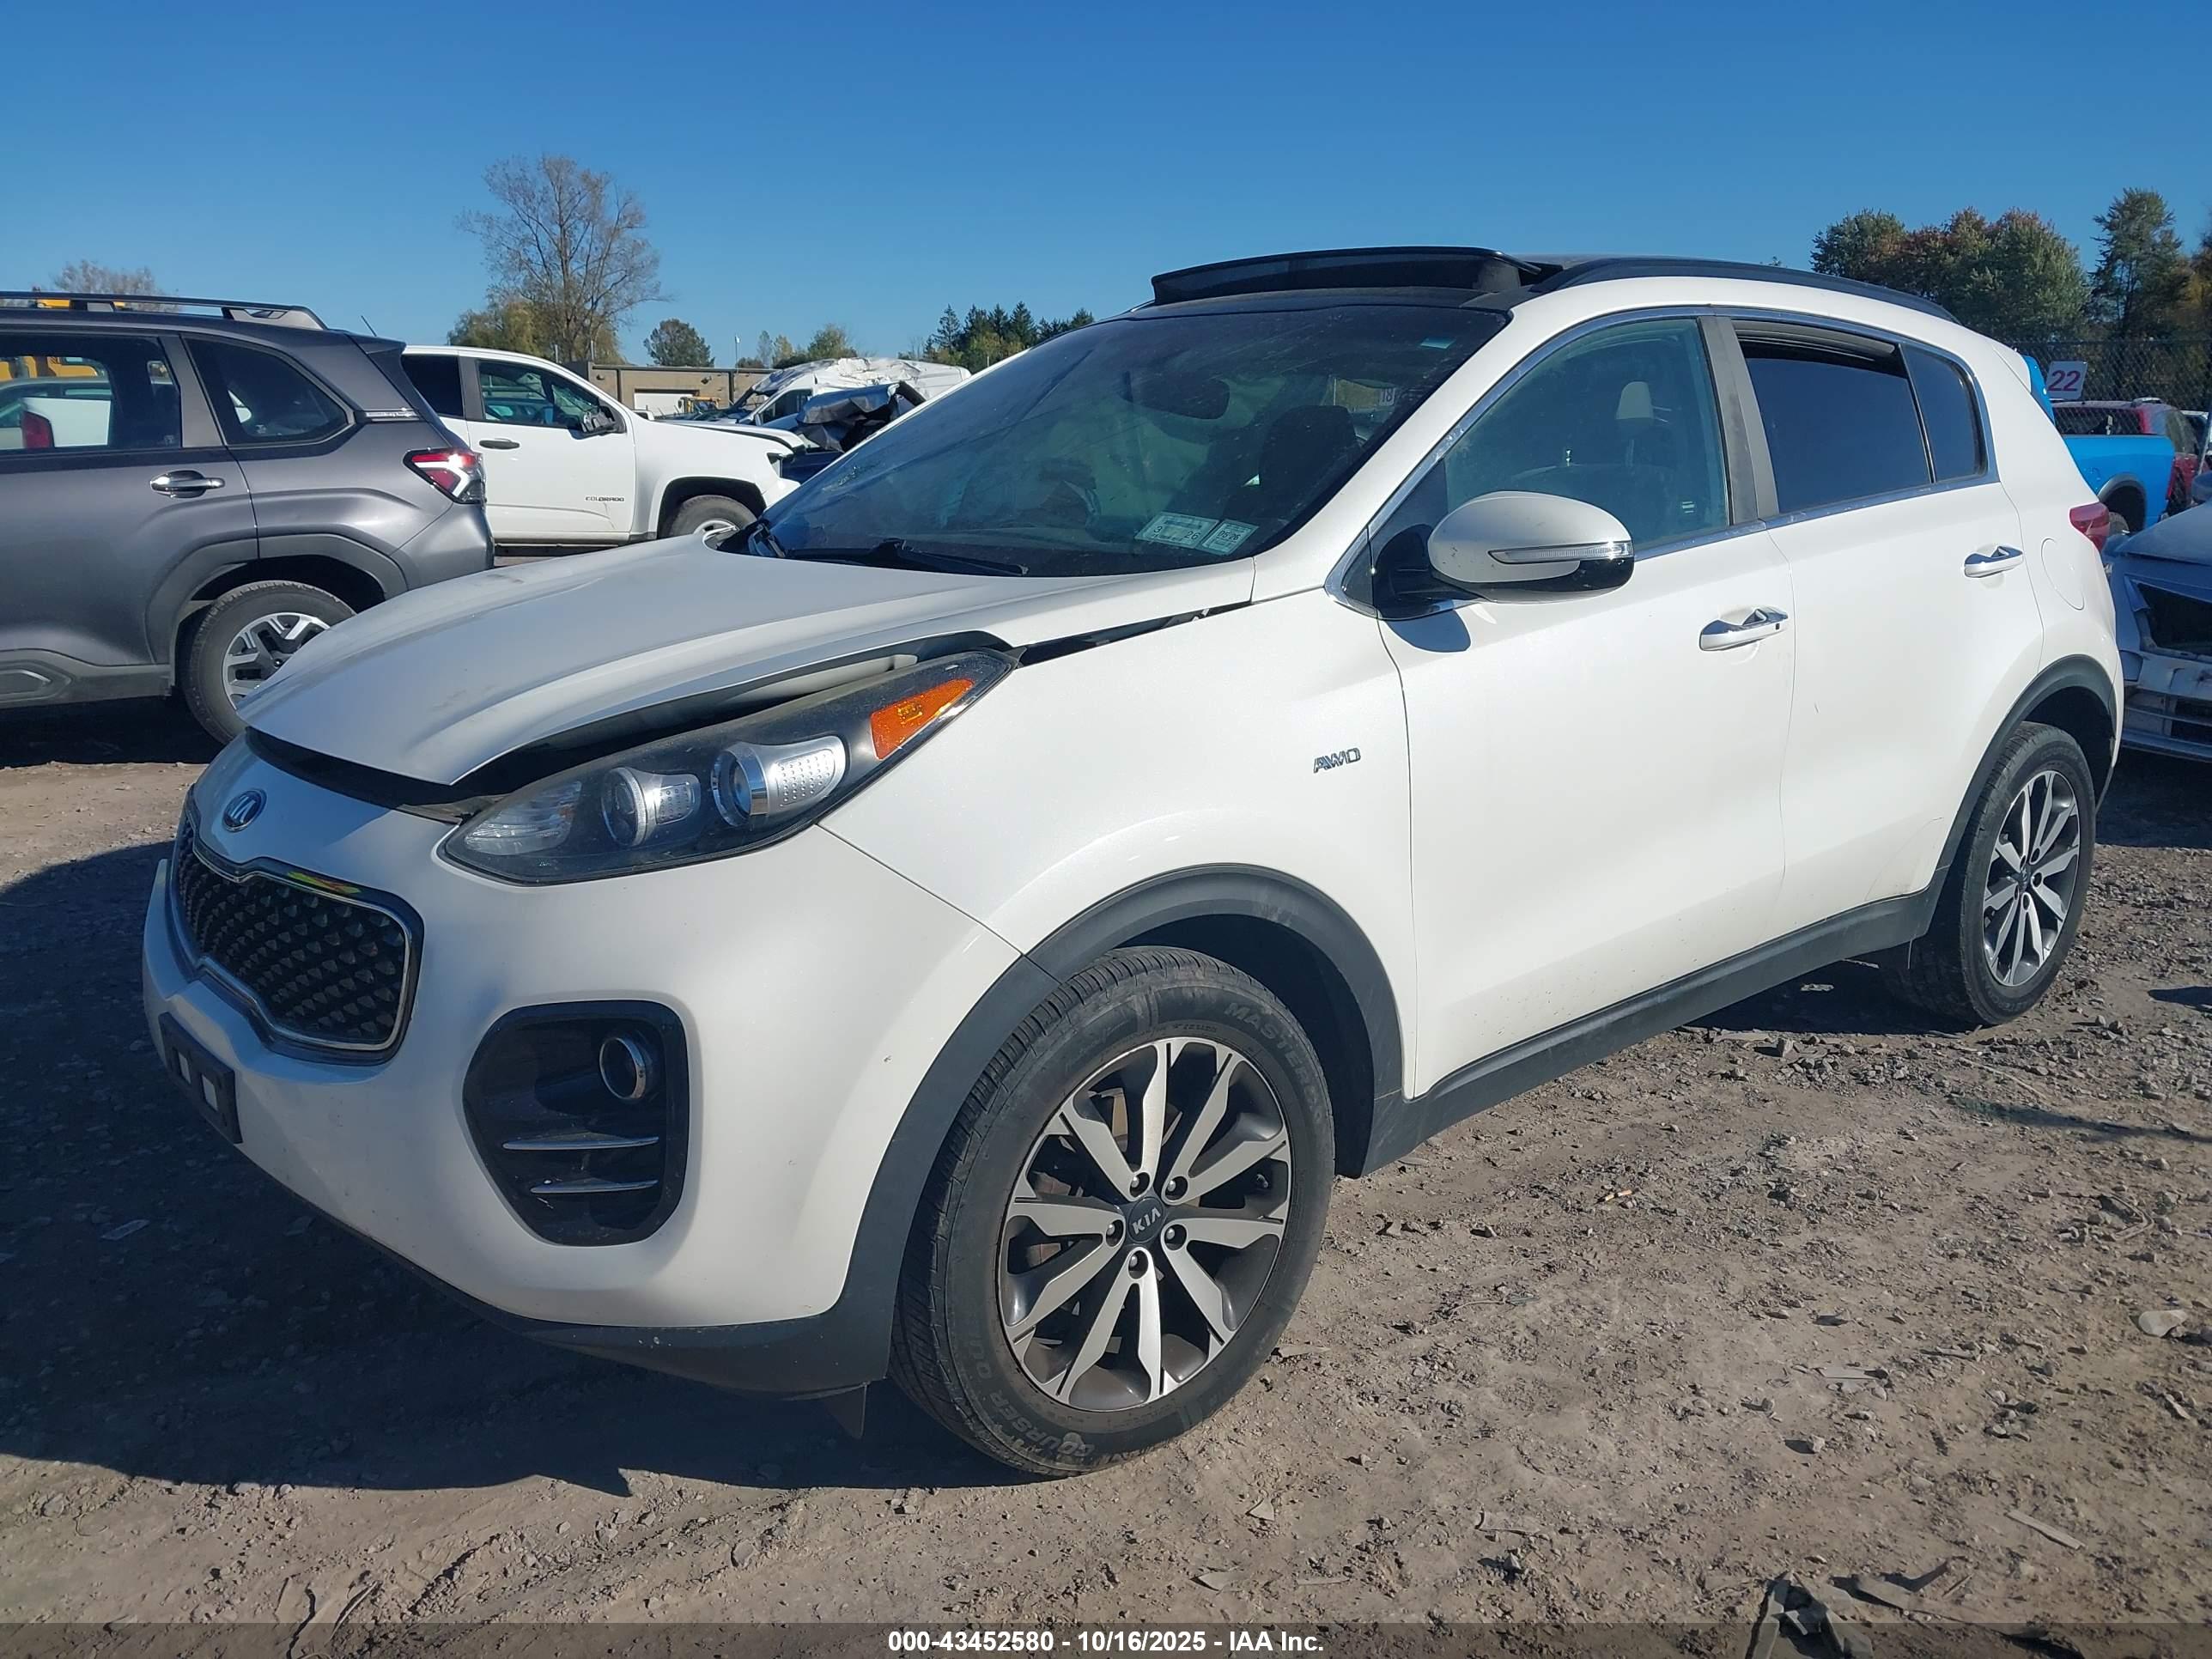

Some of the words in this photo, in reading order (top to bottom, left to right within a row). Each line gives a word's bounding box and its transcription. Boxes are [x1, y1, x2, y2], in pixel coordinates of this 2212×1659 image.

[2047, 370, 2081, 392] 22
[1183, 532, 1201, 540] 26
[1313, 747, 1361, 774] AWD
[1132, 1207, 1161, 1235] KIA
